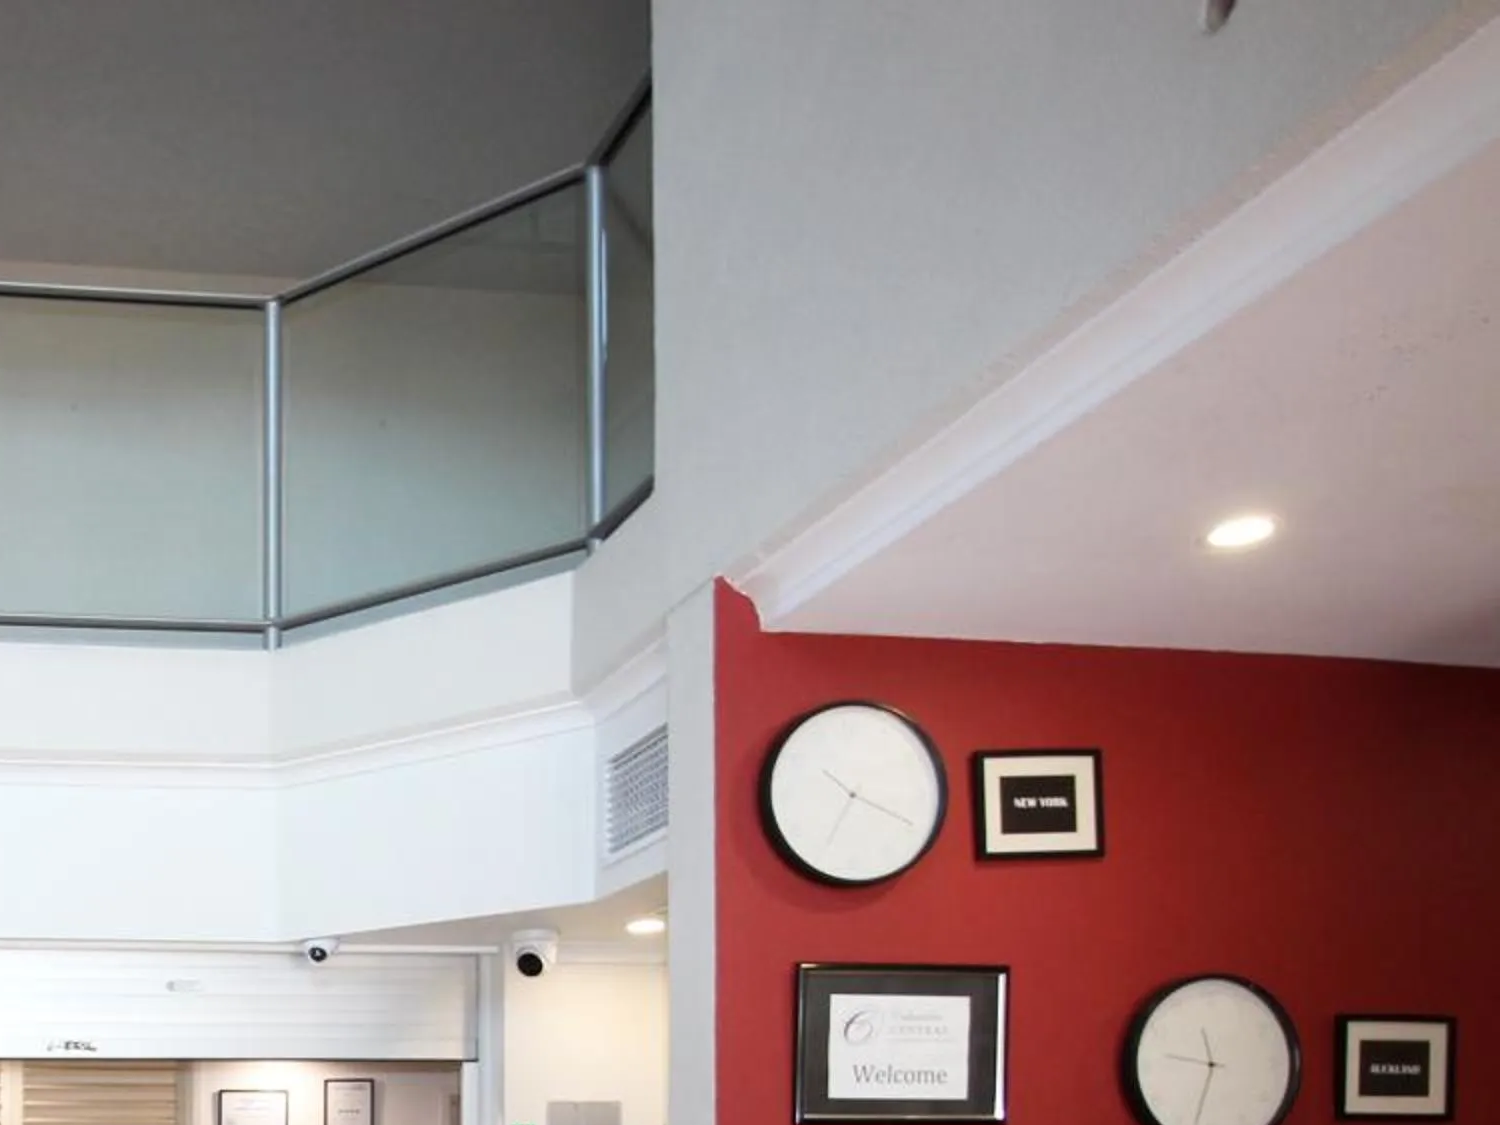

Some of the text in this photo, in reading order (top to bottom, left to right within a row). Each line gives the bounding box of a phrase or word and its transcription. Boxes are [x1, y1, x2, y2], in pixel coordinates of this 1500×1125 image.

[1013, 796, 1069, 808] NEW YORK
[852, 1063, 949, 1085] Welcome
